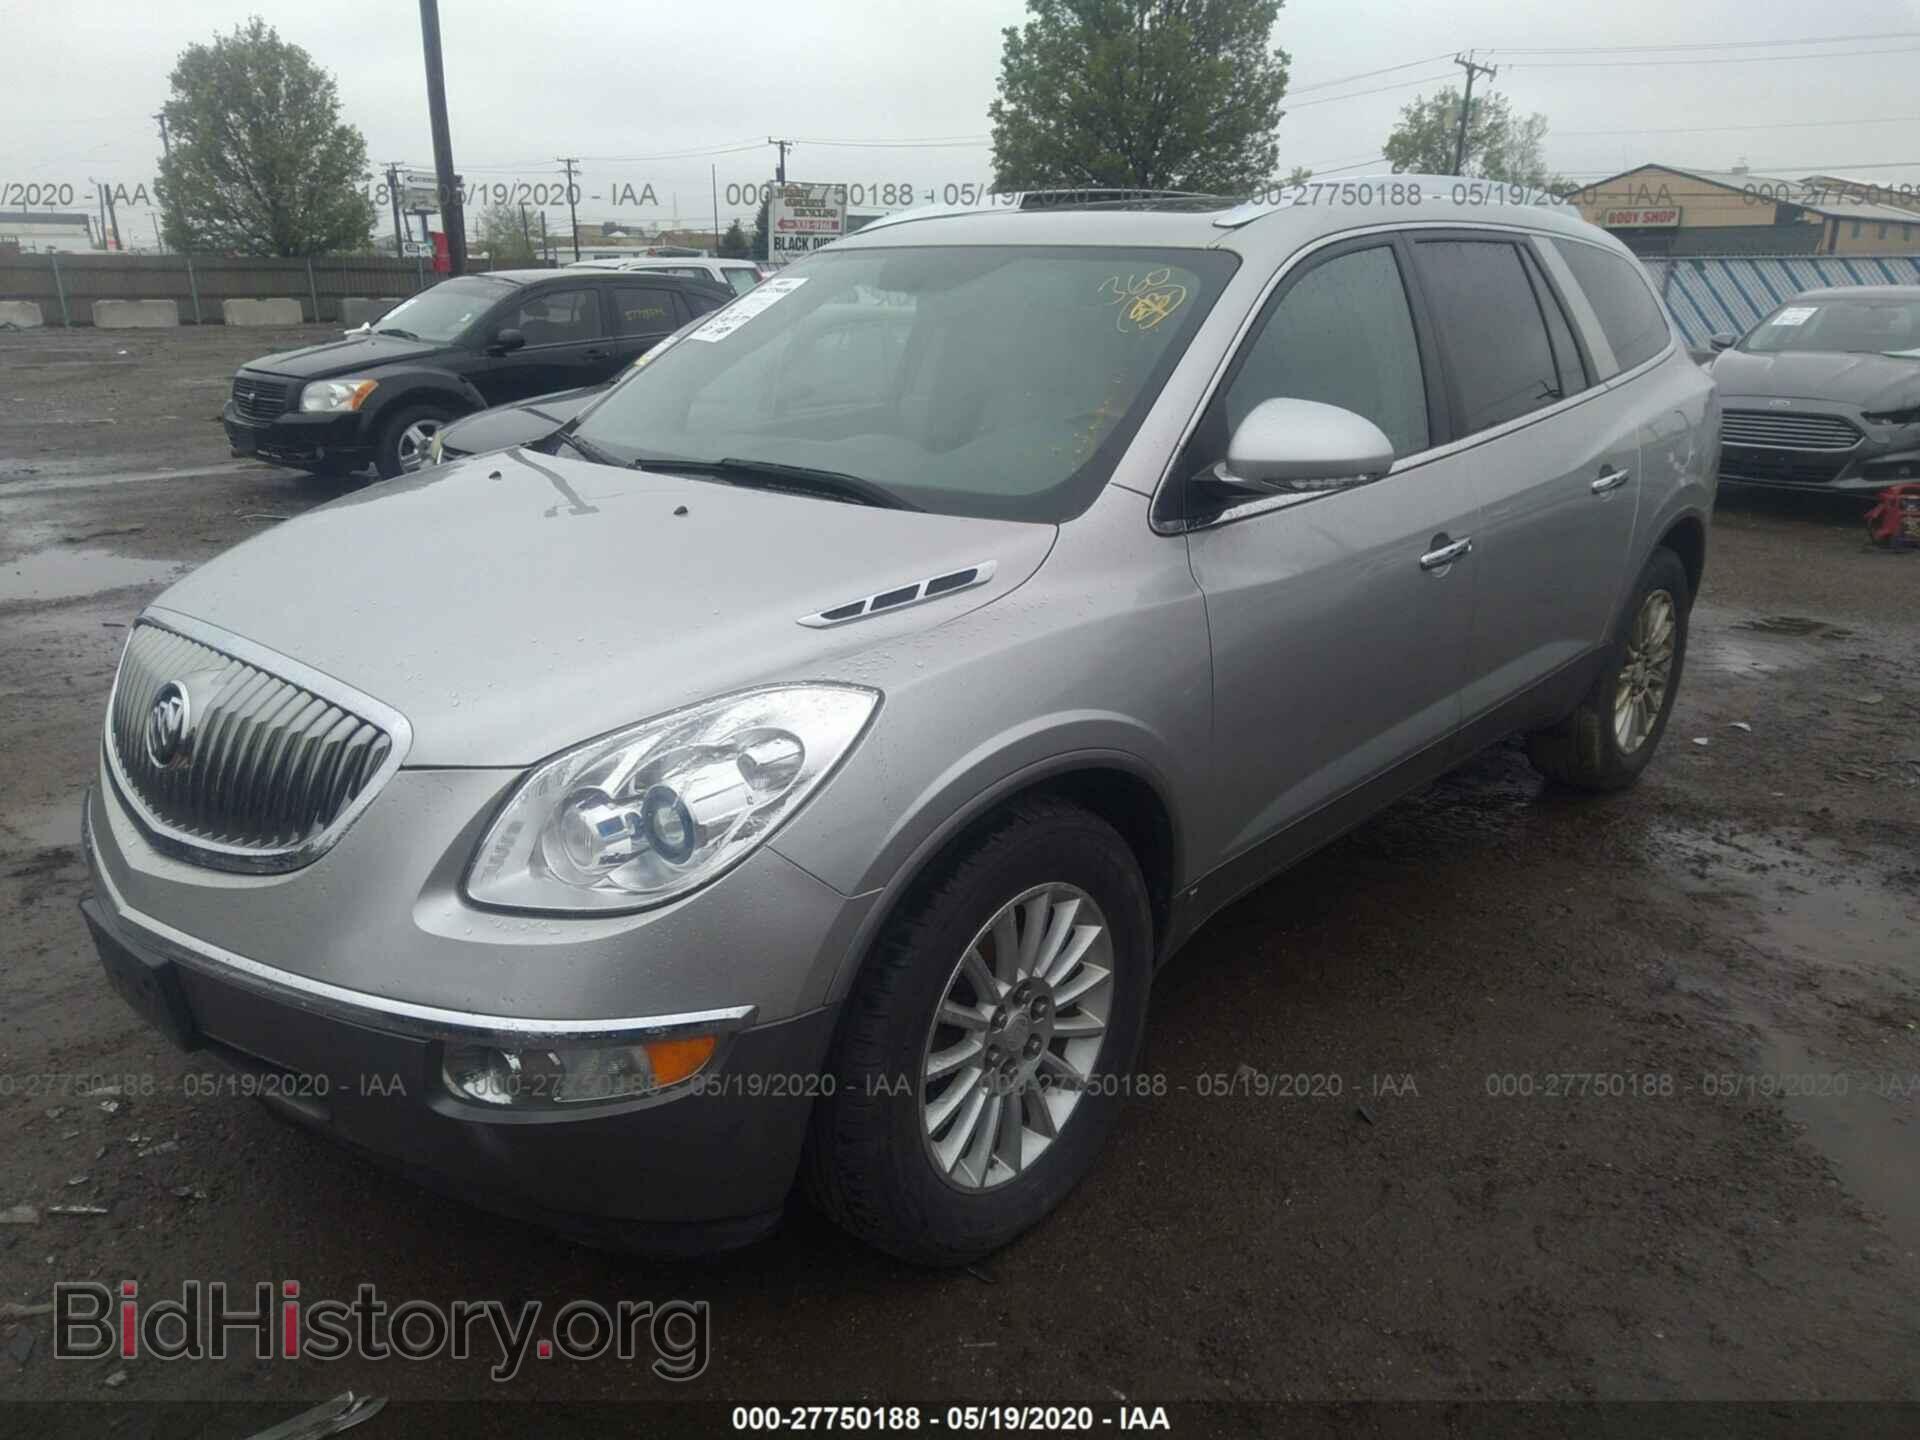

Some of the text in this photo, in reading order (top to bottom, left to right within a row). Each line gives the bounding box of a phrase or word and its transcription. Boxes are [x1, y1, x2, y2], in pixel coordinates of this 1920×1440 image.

[1607, 210, 1677, 224] BODY SHOP
[774, 236, 837, 250] BLACK DIR
